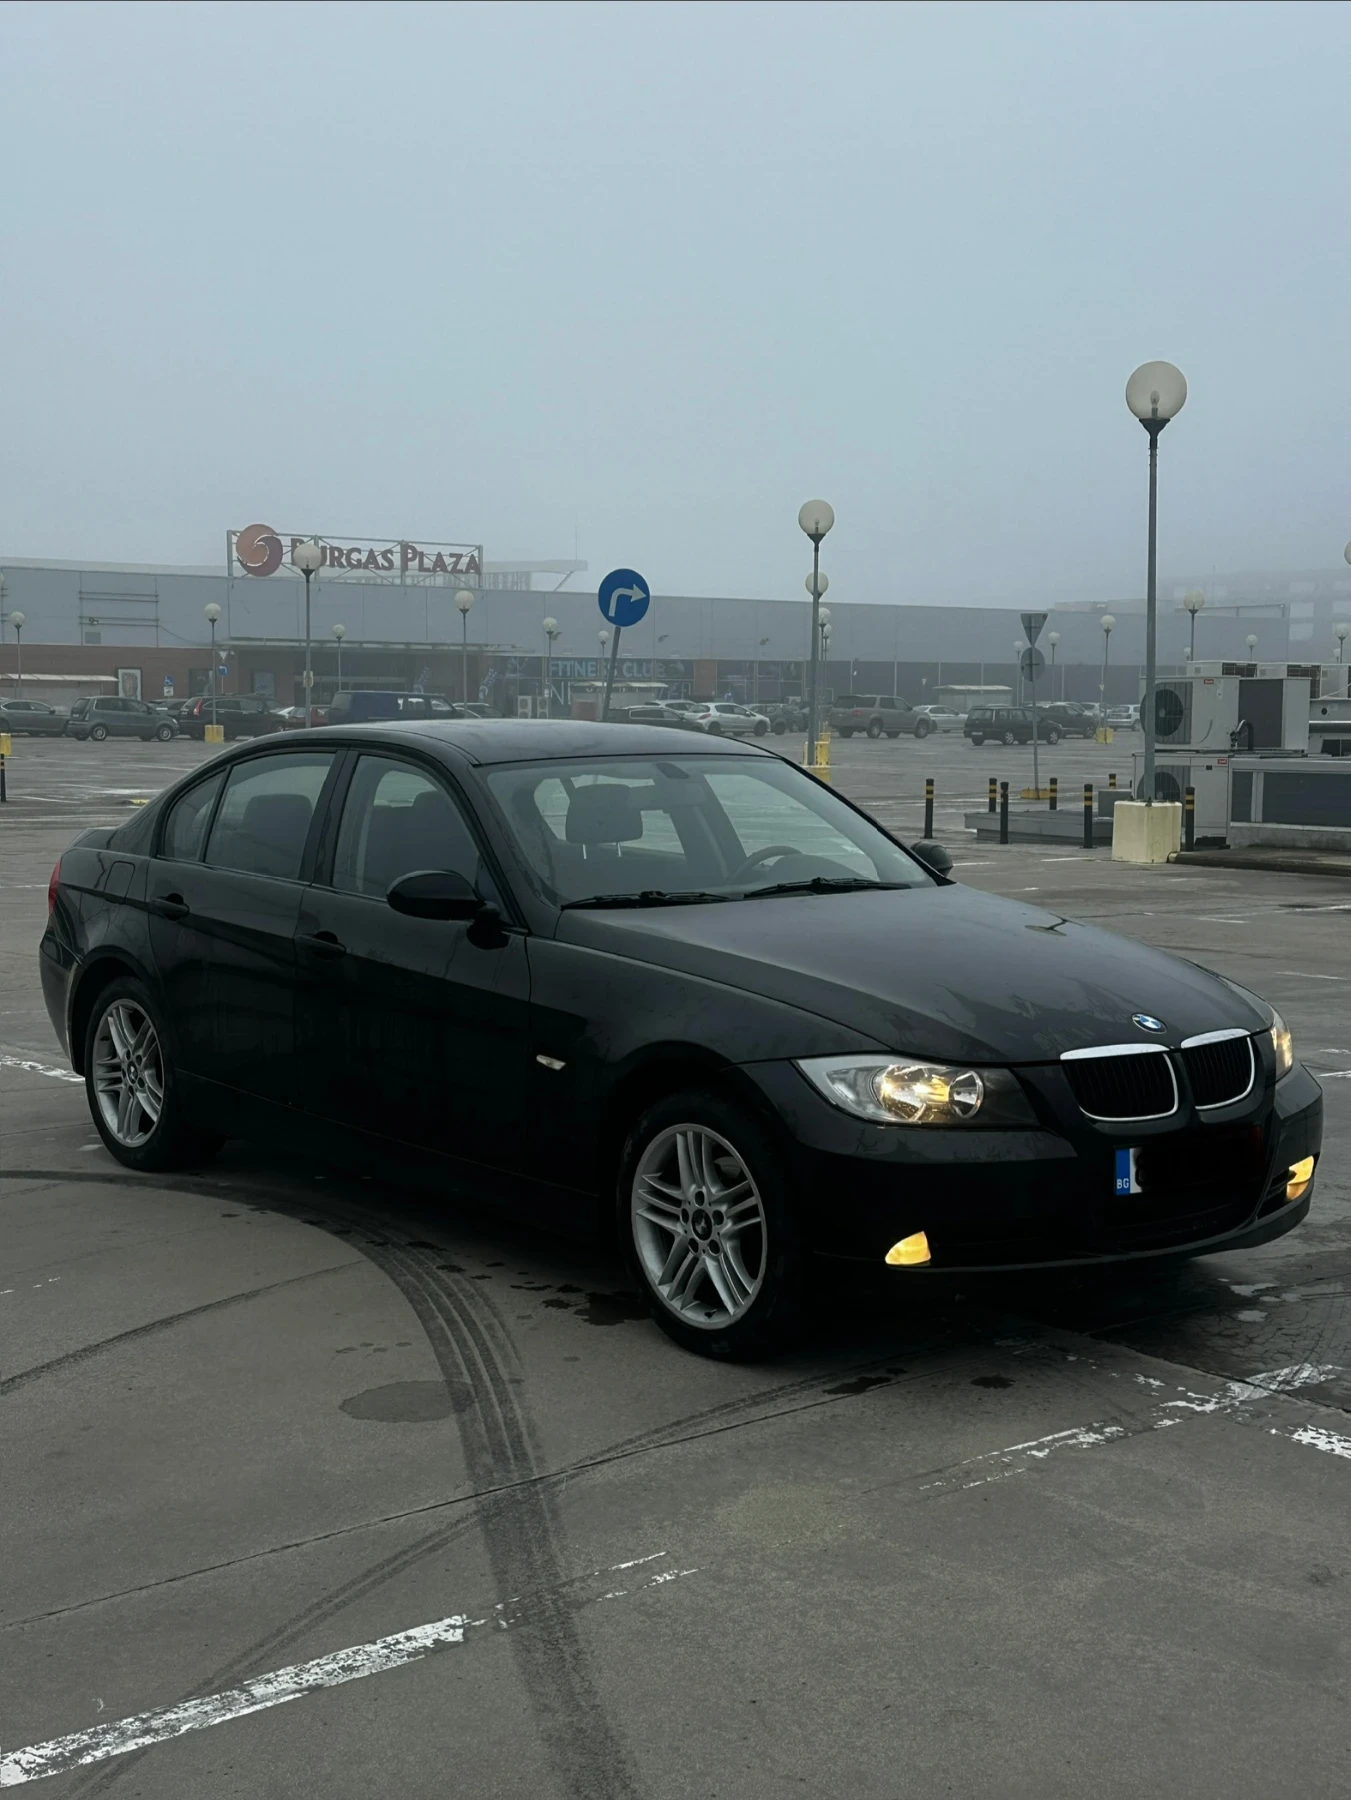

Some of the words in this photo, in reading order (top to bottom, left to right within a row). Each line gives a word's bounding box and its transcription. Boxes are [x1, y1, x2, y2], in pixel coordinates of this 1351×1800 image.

[403, 543, 481, 575] PLAZA
[621, 661, 666, 678] CLUB
[1116, 1178, 1129, 1189] BG
